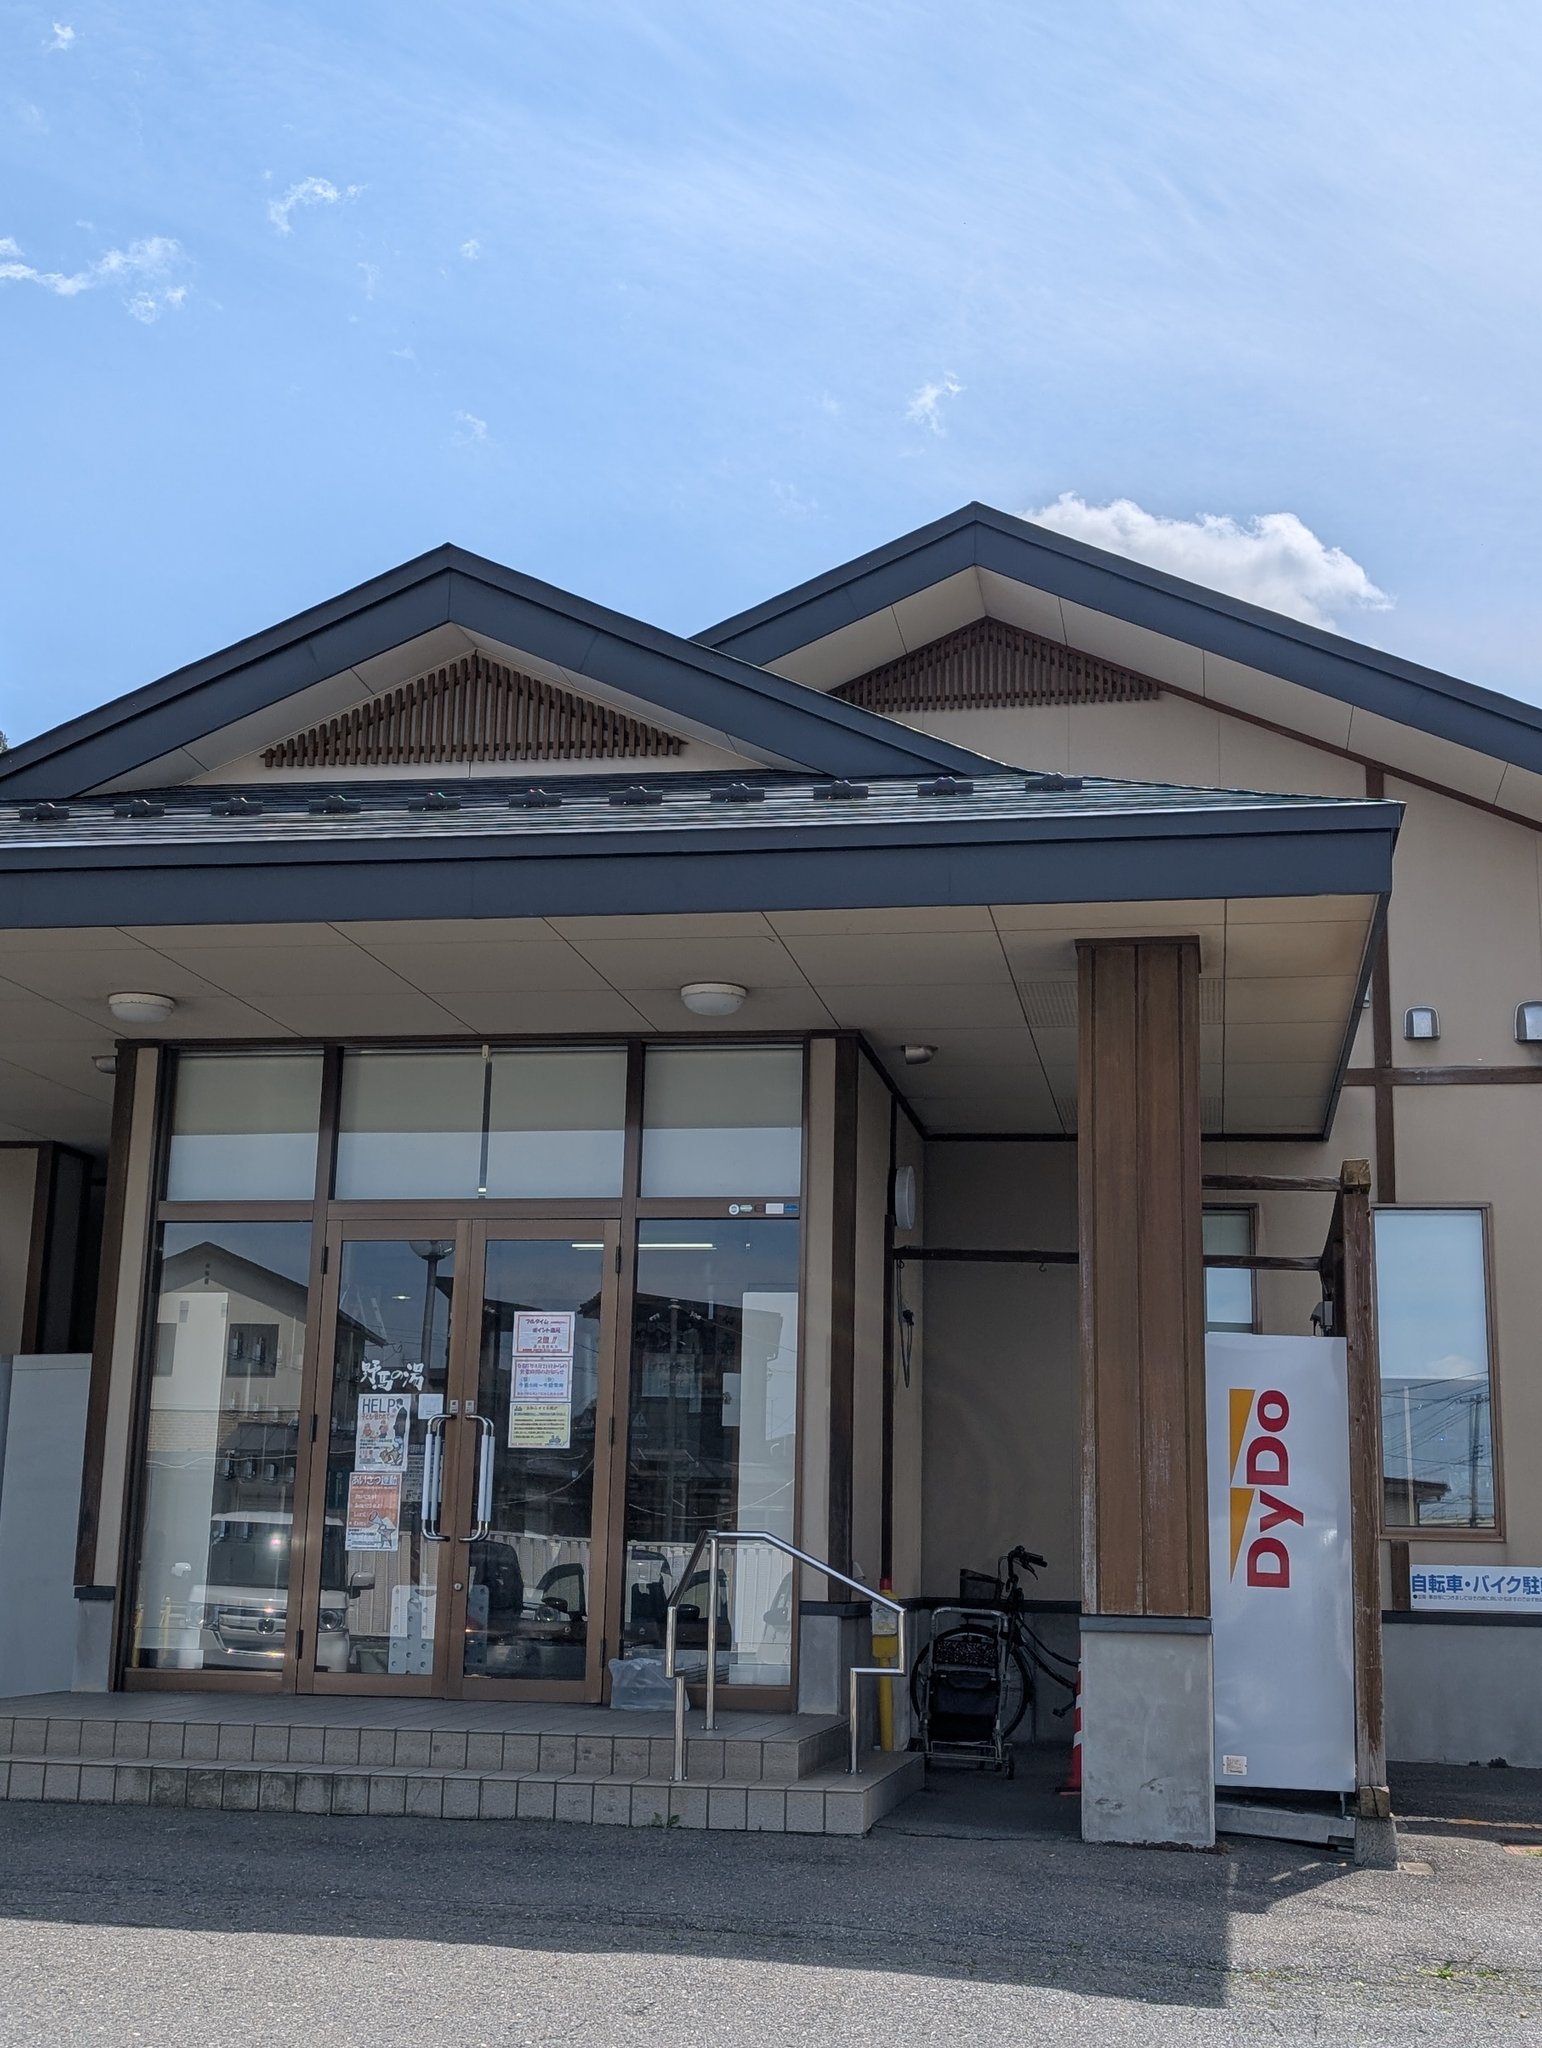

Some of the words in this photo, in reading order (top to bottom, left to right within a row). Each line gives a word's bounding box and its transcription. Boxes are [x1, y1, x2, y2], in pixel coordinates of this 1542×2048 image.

[360, 1359, 424, 1391] 野馬の湯
[1246, 1389, 1305, 1589] DyDo
[1411, 1574, 1542, 1595] 自転車・バイク駐
